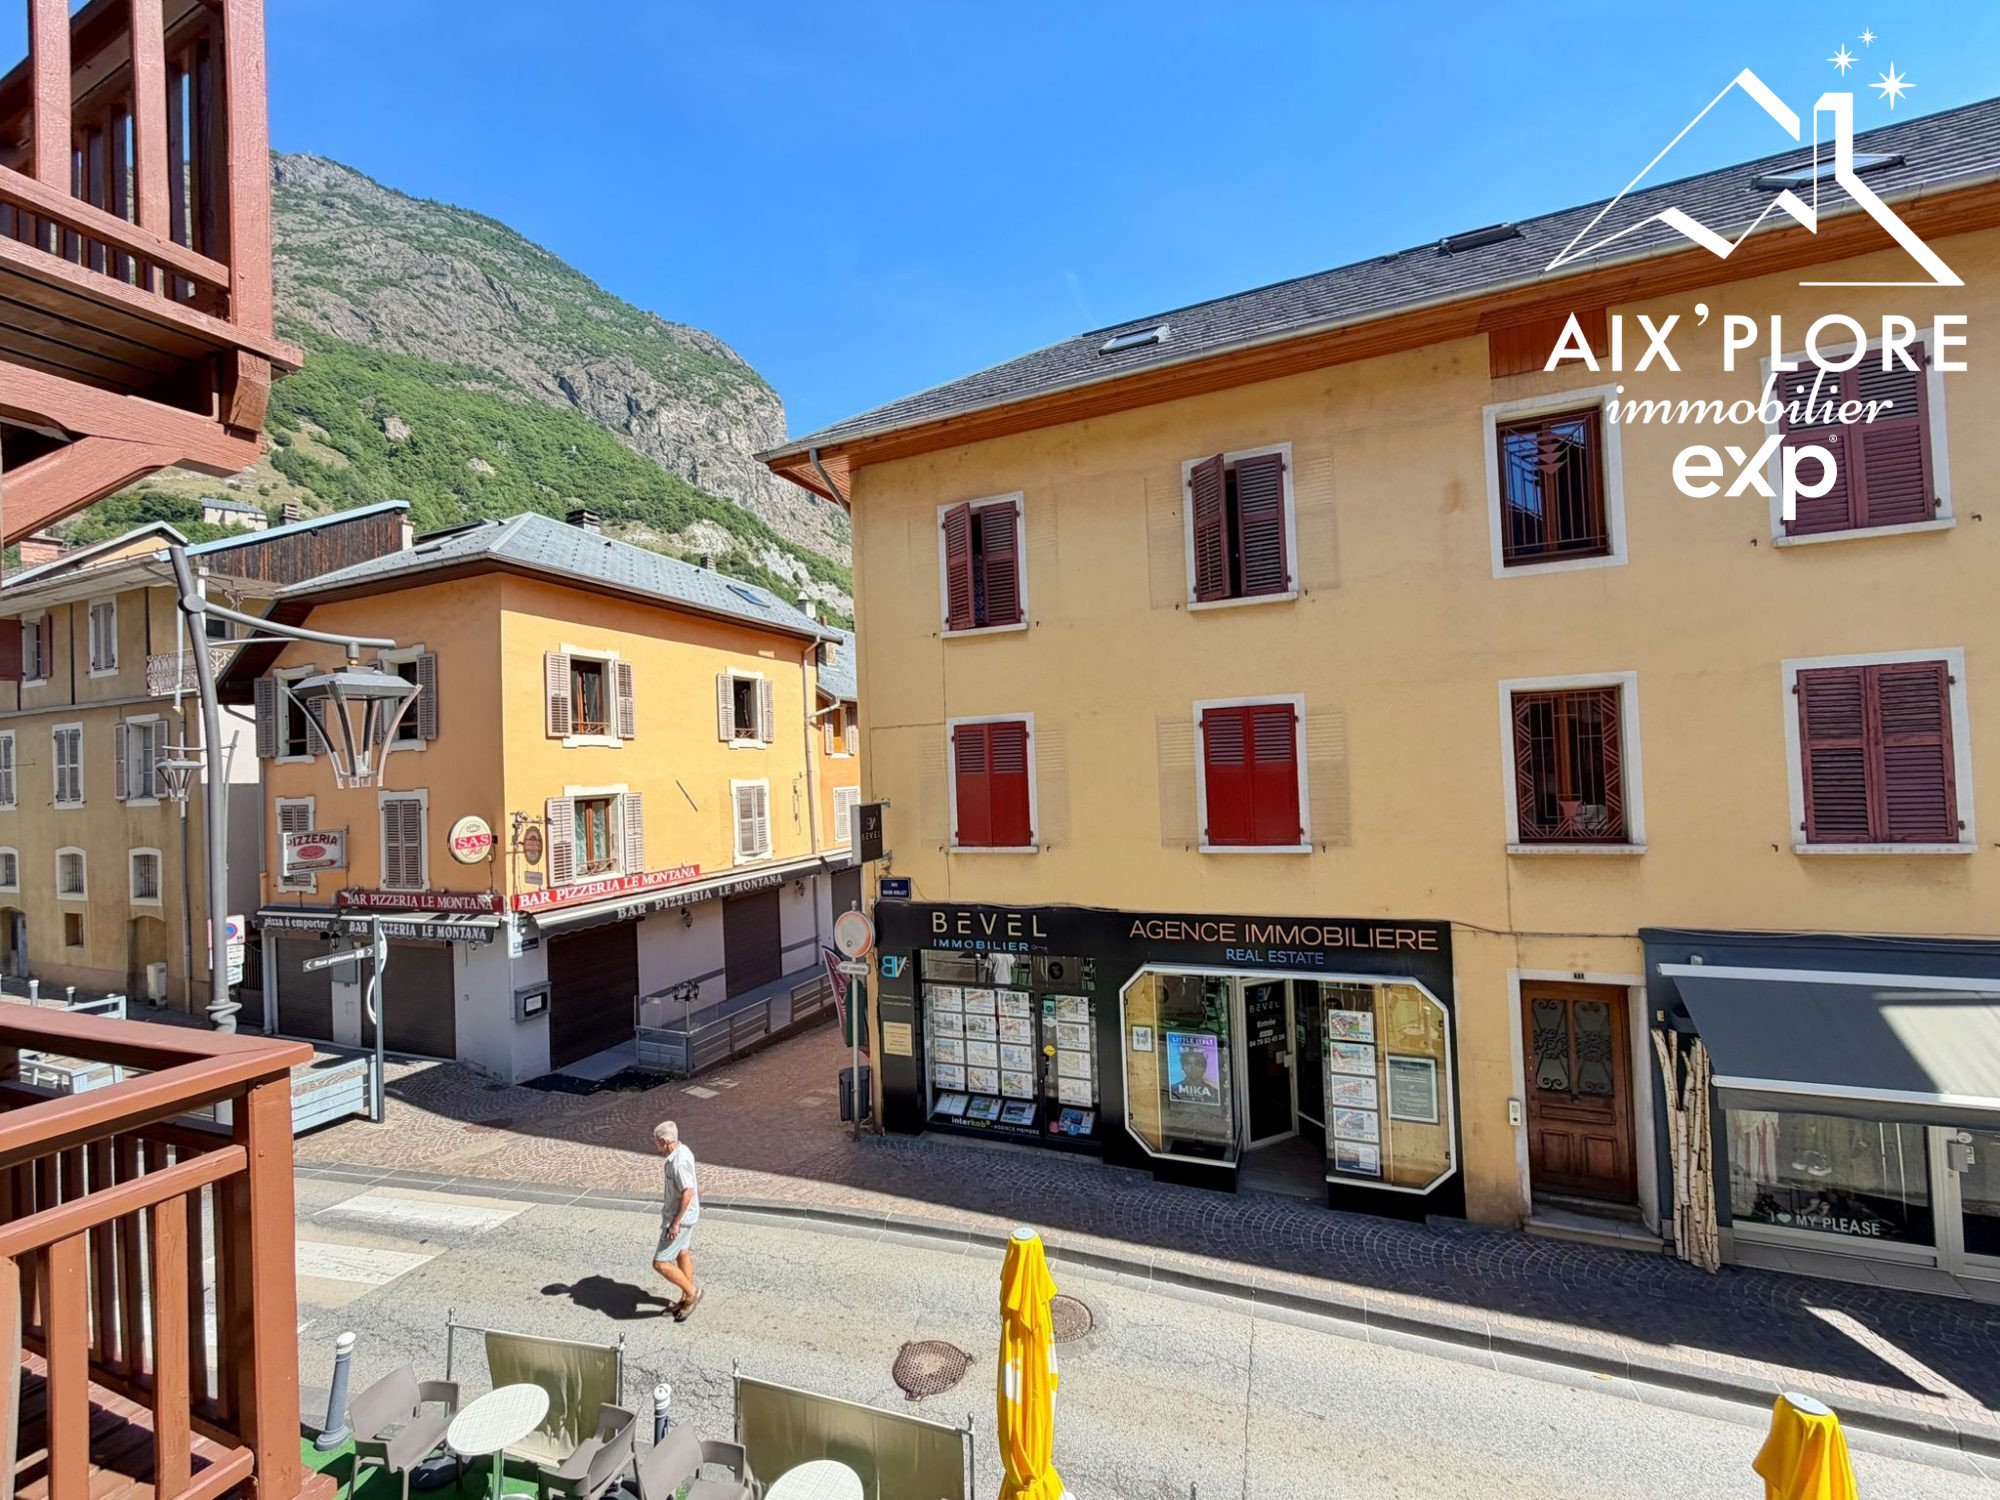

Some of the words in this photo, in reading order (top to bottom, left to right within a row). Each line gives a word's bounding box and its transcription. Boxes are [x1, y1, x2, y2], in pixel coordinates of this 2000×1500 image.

[456, 834, 490, 849] SAS
[520, 892, 551, 908] BAR
[556, 880, 620, 901] PIZZERIA
[624, 876, 640, 889] LE
[642, 867, 695, 885] MONTANA
[617, 904, 646, 919] BAR
[655, 888, 712, 911] PIZZERIA
[718, 884, 732, 897] LE
[735, 873, 783, 893] MONTANA
[347, 893, 368, 906] BAR
[370, 894, 418, 907] PIZZERIA
[421, 896, 434, 908] LE
[437, 896, 494, 910] MONTANA
[264, 917, 284, 928] pizza
[291, 919, 330, 930] emporter
[349, 922, 368, 933] BAR
[422, 925, 434, 937] LE
[436, 927, 487, 940] MONTANA
[932, 911, 1048, 938] BEVEL
[1130, 920, 1237, 942] AGENCE
[1245, 923, 1439, 950] IMMOBILIERE
[933, 939, 1029, 951] IMMOBILIER
[314, 959, 328, 967] Rue
[1226, 948, 1263, 963] REAL
[1268, 950, 1324, 965] ESTATE
[1249, 1001, 1281, 1013] BEVEL
[1178, 1084, 1212, 1097] MIKA
[1796, 1214, 1817, 1228] MY
[1823, 1217, 1881, 1236] PLEASE
